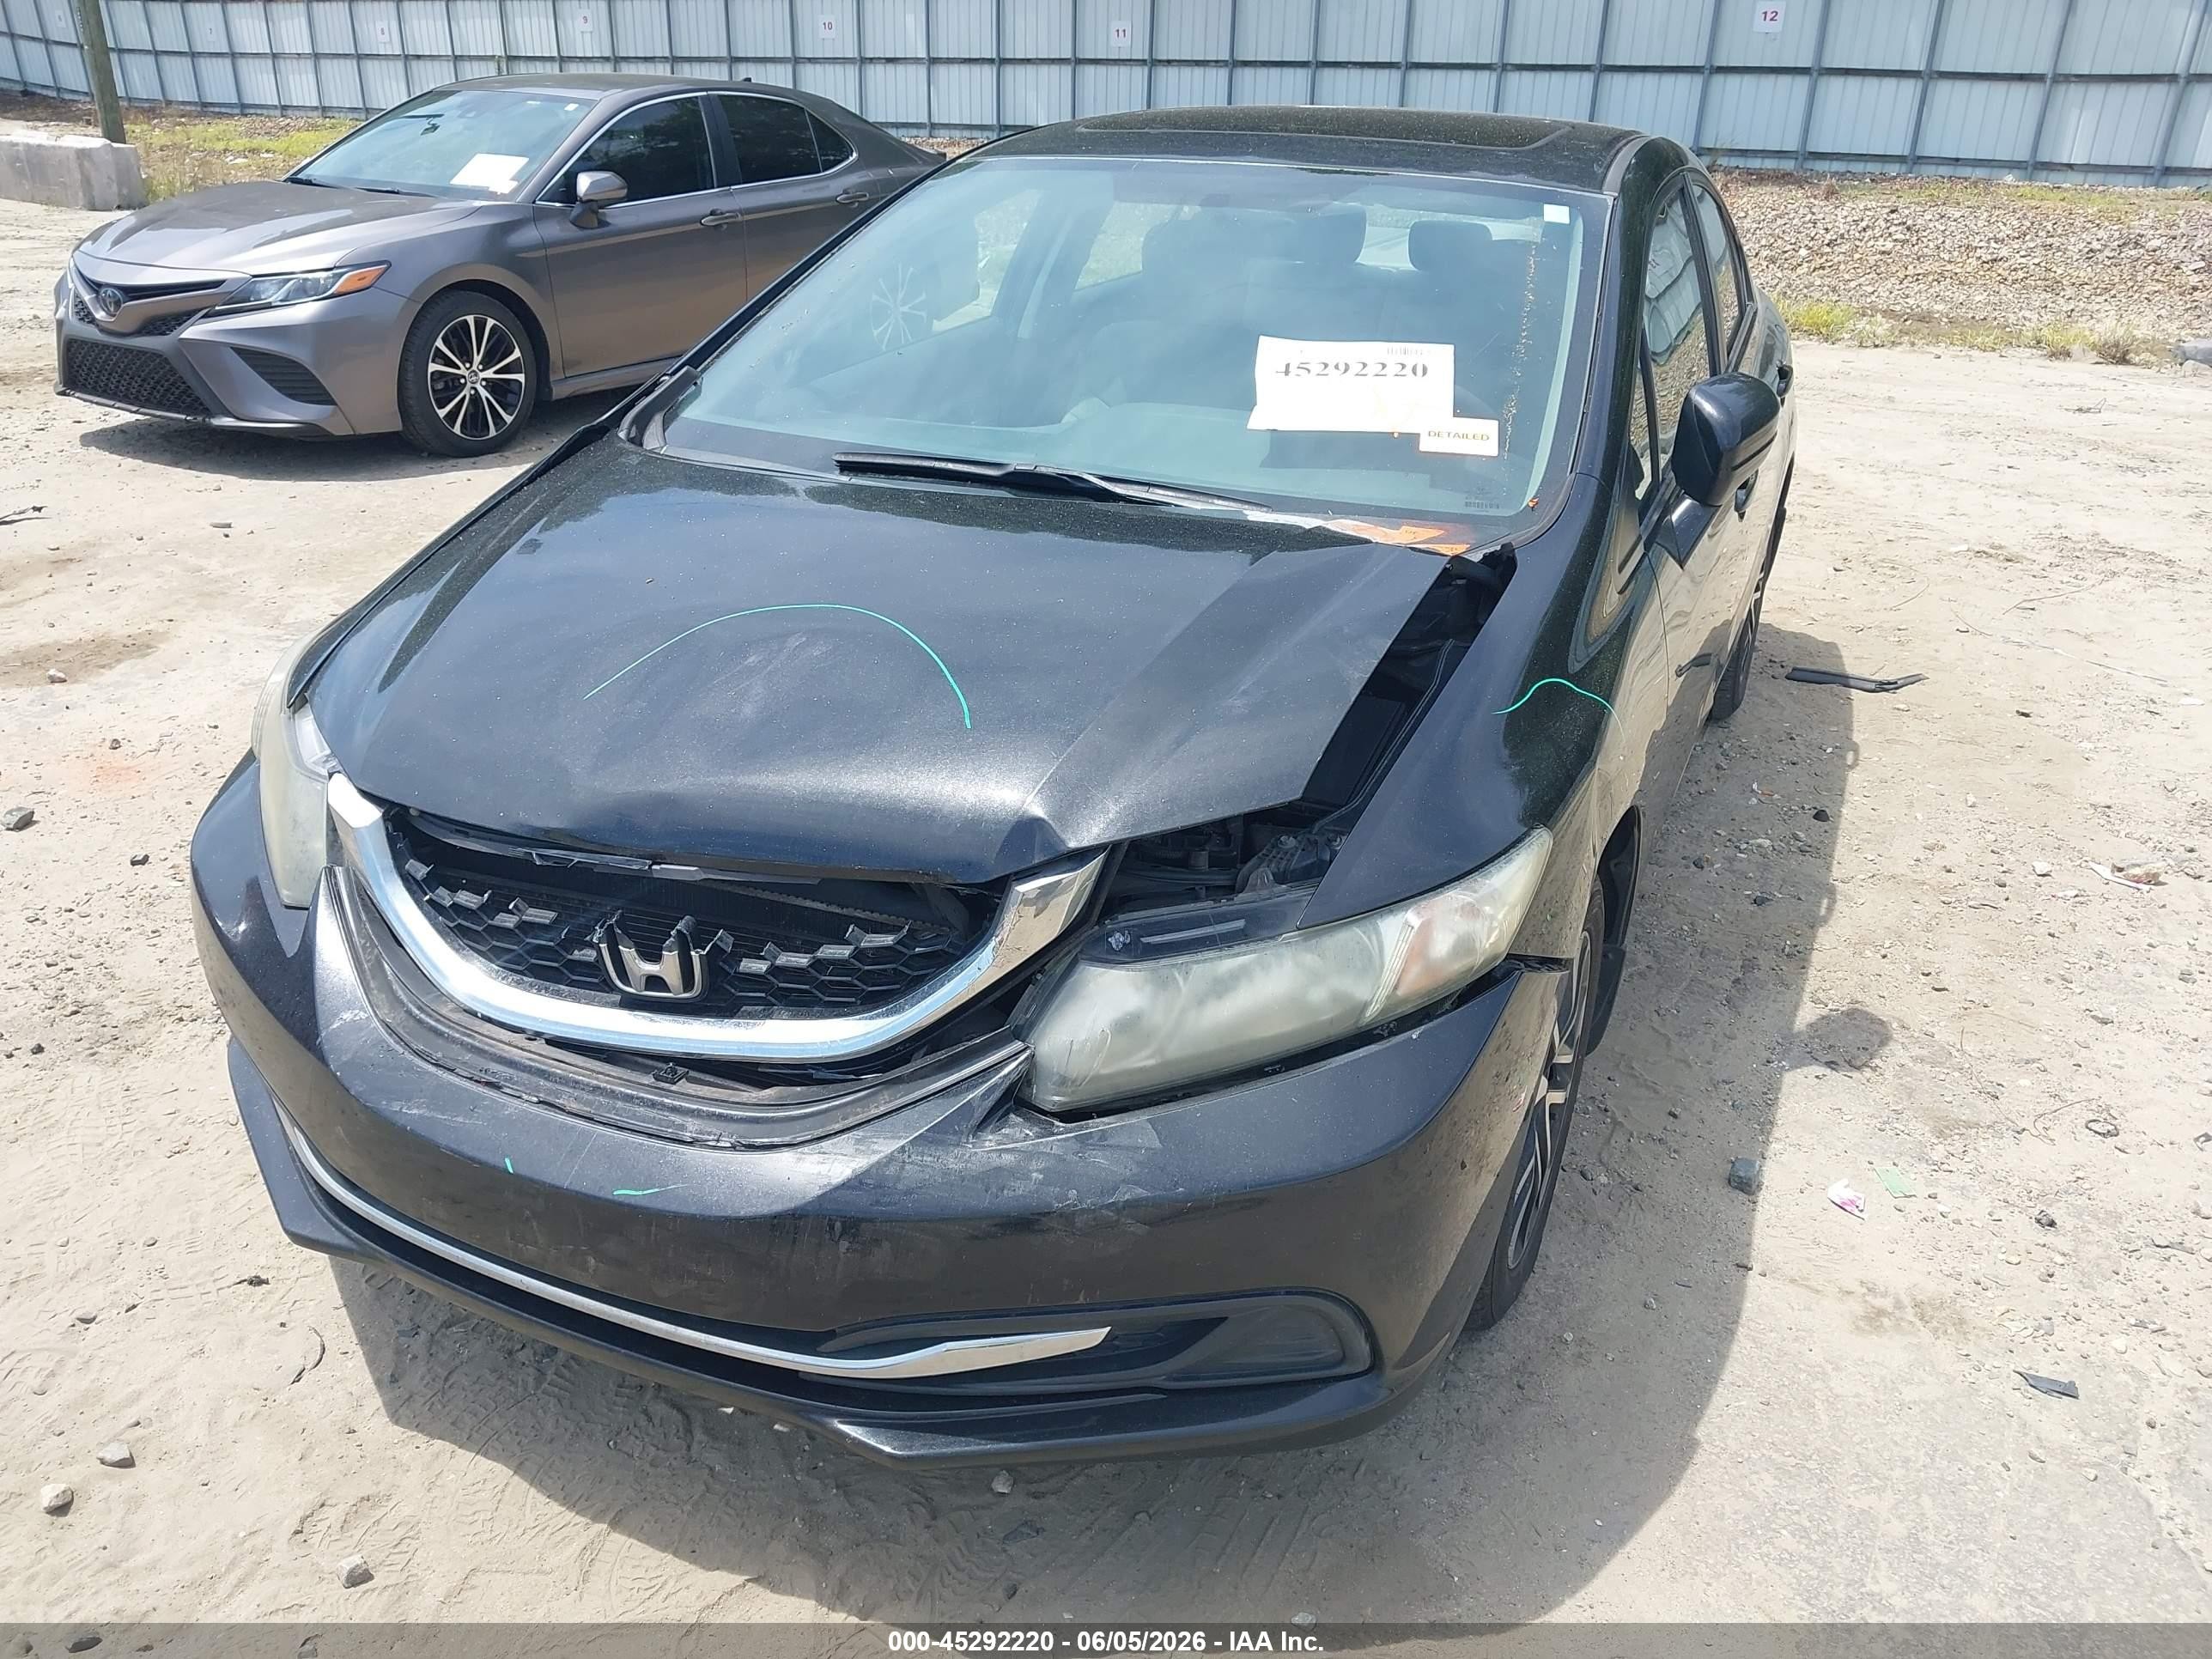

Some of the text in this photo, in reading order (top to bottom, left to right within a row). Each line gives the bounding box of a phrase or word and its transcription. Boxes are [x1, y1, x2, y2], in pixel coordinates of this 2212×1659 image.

[582, 15, 588, 24] 9
[1761, 10, 1779, 21] 12
[822, 21, 833, 31] 10
[1115, 28, 1127, 39] 11
[1275, 362, 1429, 378] 45292220
[1427, 430, 1491, 441] DETAILED
